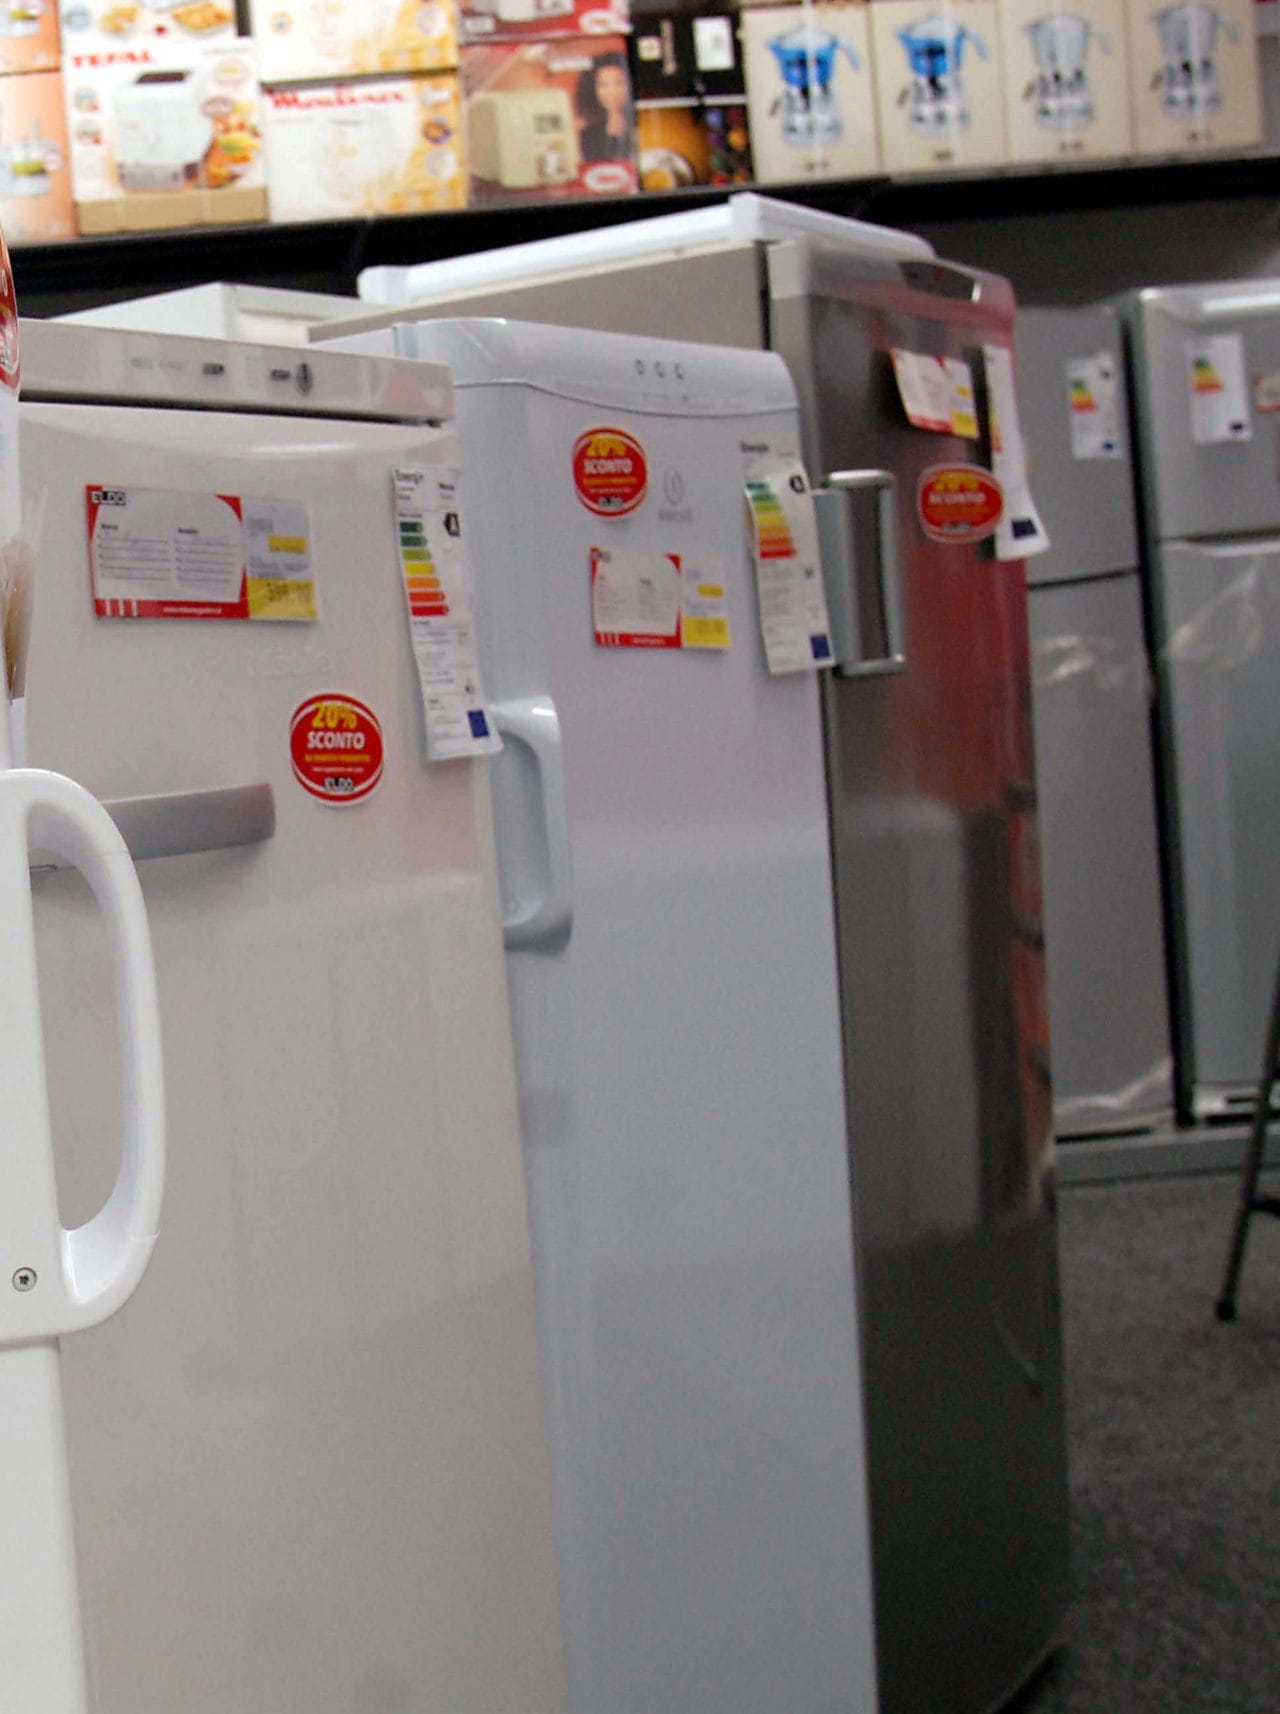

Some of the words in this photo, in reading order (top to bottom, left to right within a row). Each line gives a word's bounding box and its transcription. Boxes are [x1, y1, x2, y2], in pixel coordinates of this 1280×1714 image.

[72, 50, 158, 68] TEFAL
[312, 702, 358, 729] 20%
[306, 731, 366, 750] SCONTO
